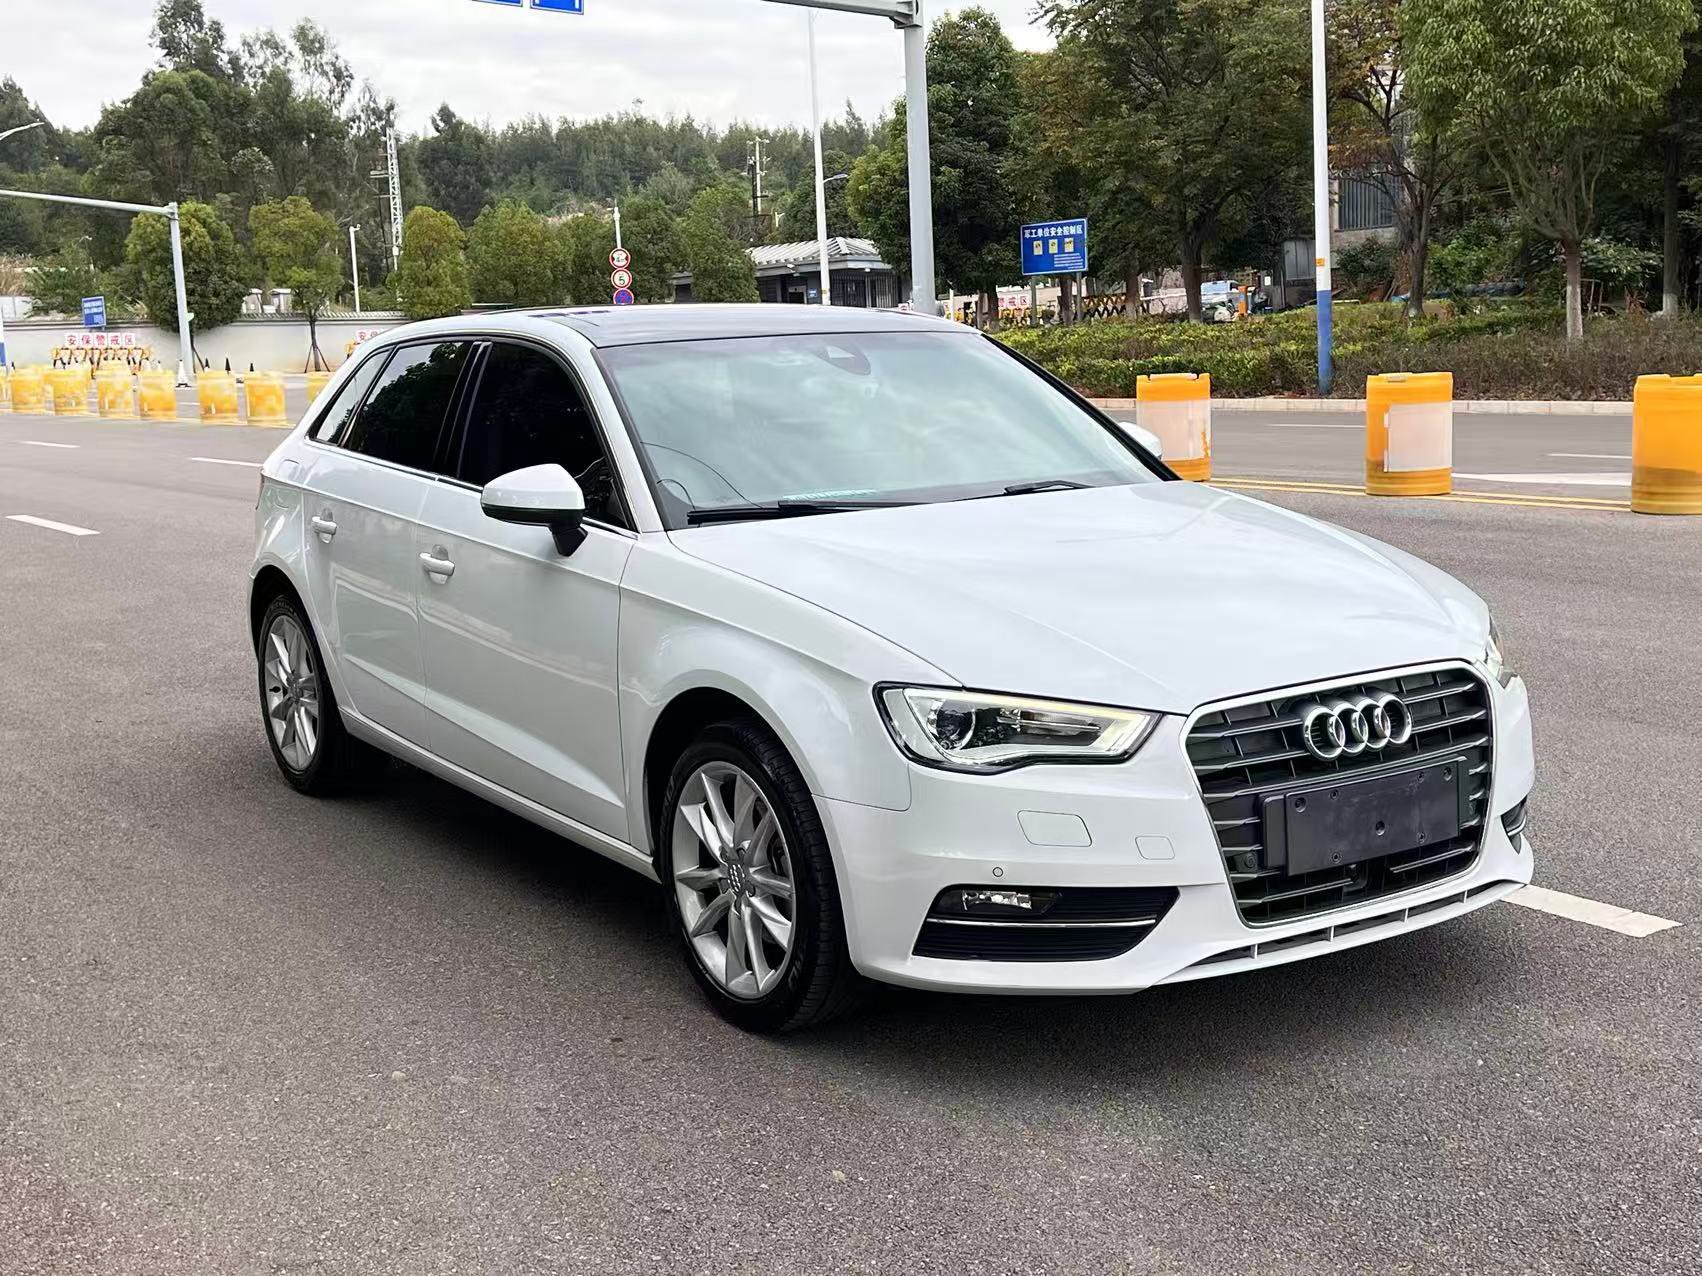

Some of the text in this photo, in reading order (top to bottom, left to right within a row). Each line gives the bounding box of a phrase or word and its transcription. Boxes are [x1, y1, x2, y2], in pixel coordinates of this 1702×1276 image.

[618, 275, 626, 285] 5
[66, 334, 134, 346] 安保警戒区
